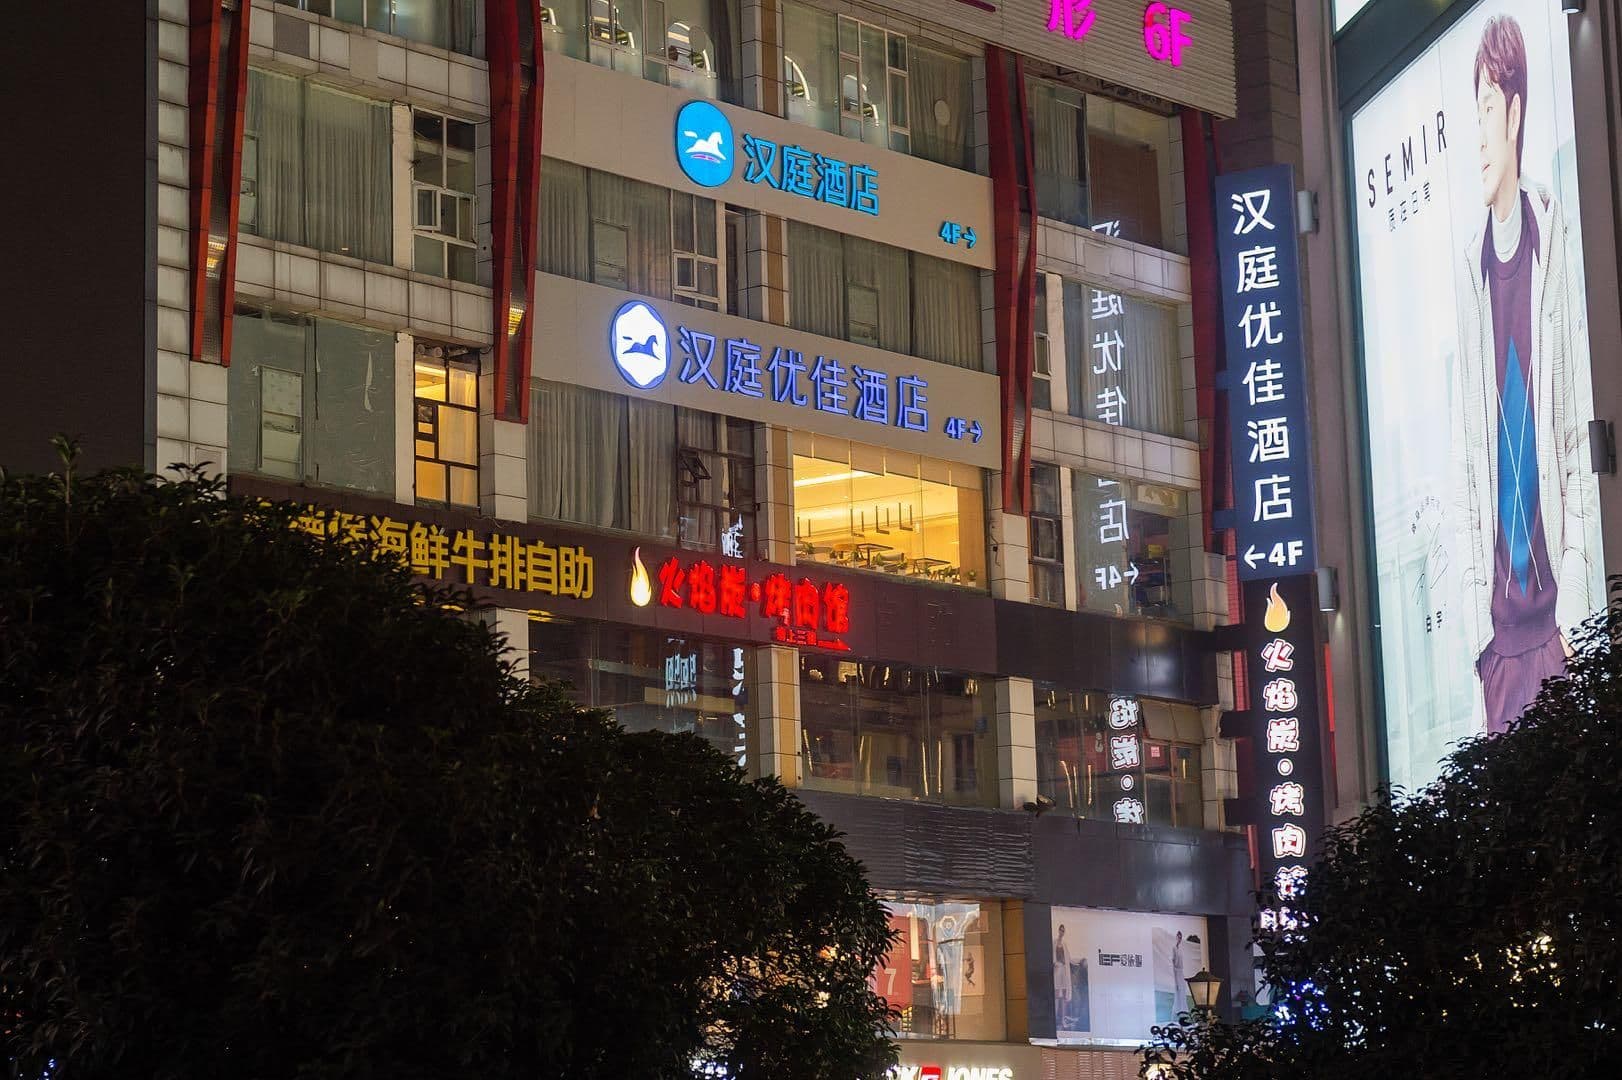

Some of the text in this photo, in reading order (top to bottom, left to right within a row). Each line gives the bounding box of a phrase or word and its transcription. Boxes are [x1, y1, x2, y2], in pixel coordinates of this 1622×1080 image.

[1143, 2, 1193, 67] 6F
[743, 133, 880, 216] 汉庭酒店
[1367, 110, 1447, 208] SEMIR
[939, 221, 962, 245] 4F
[677, 326, 929, 433] 汉庭优佳酒店
[1231, 189, 1294, 523] 汉庭优佳酒店
[944, 417, 967, 440] 4F
[1268, 540, 1304, 568] 4F
[884, 968, 897, 996] 7
